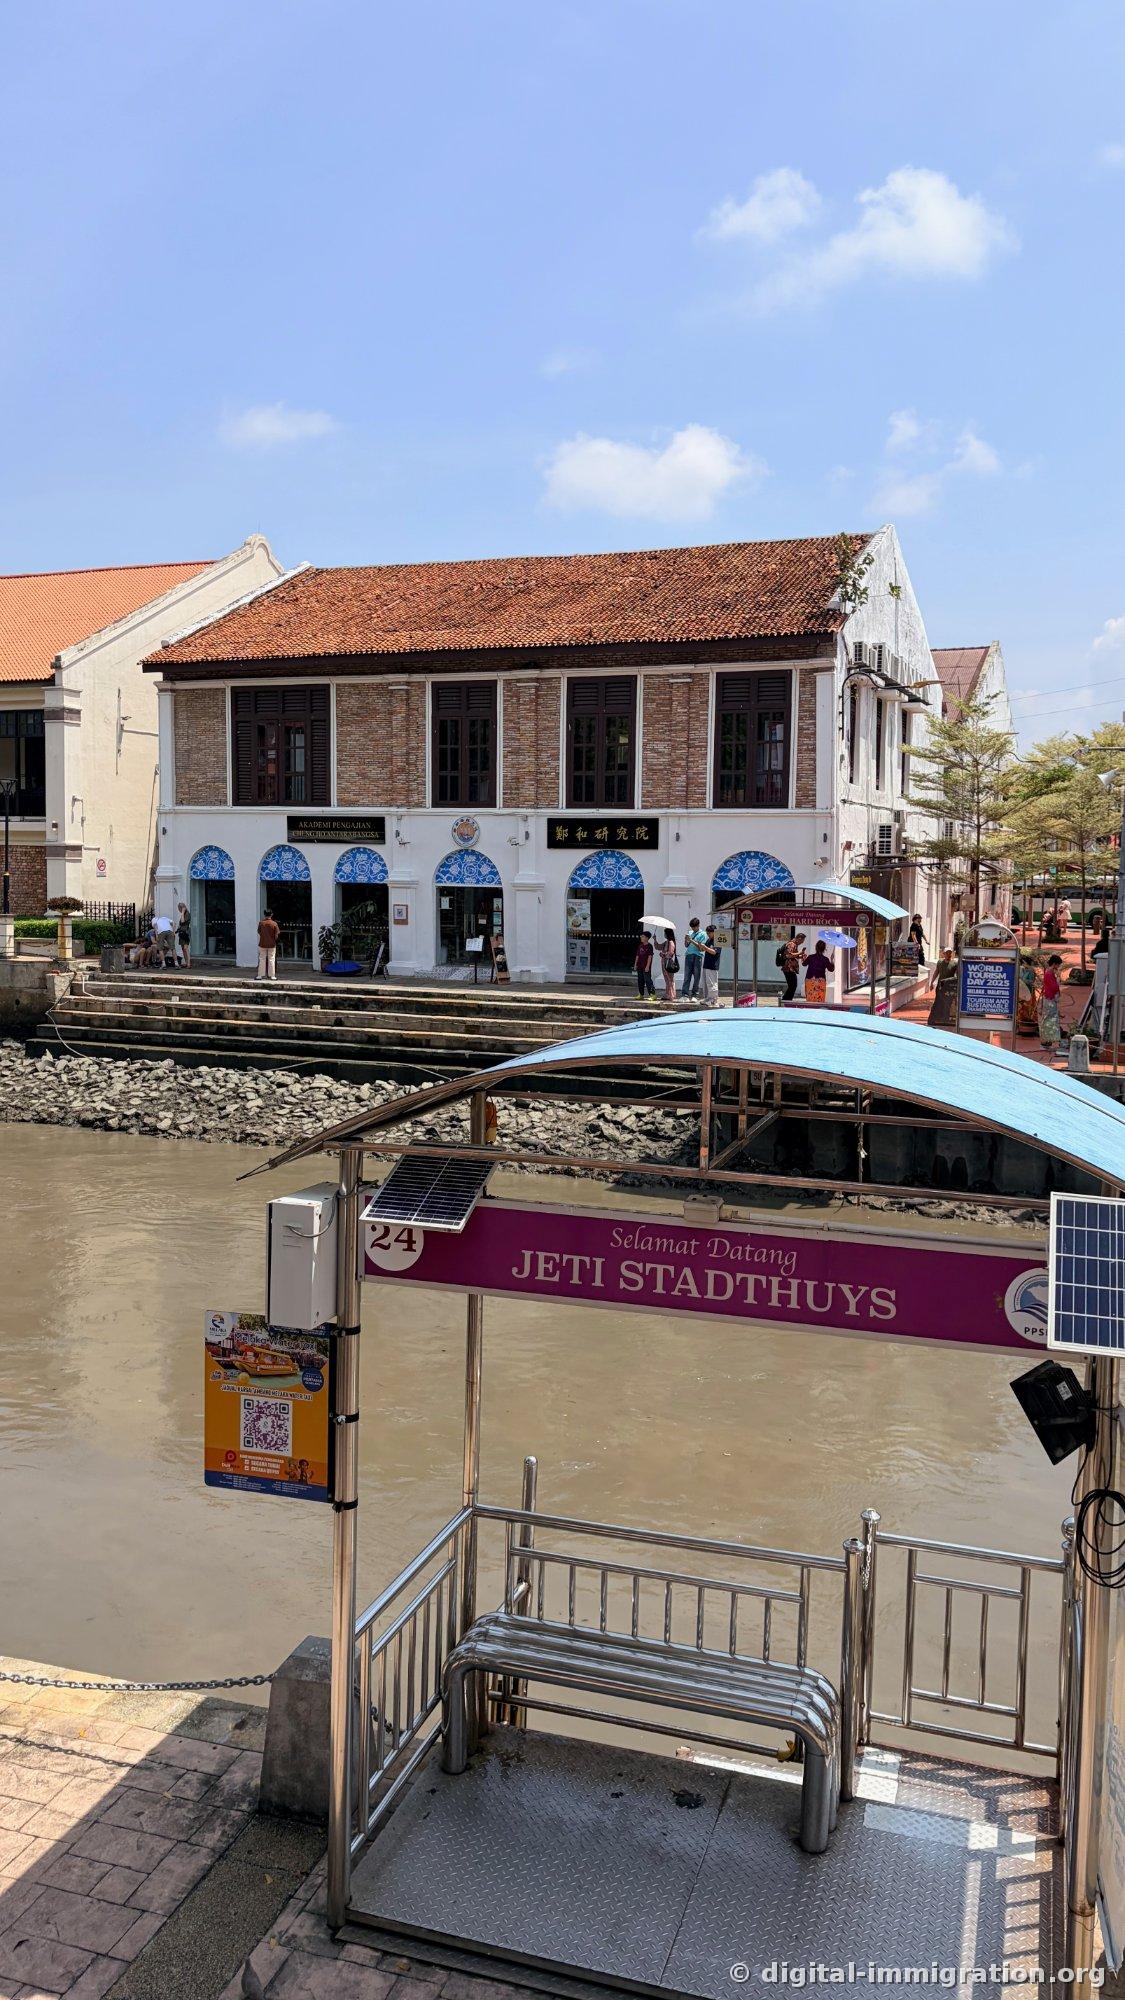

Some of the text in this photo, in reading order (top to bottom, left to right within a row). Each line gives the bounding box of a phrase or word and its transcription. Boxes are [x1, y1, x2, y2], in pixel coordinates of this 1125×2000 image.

[298, 821, 371, 829] AKADEMI PENGAJIAN
[769, 917, 789, 925] JETI
[814, 918, 840, 926] ROCK
[967, 964, 1003, 972] WORLD
[967, 971, 1007, 980] TOURISM
[967, 978, 985, 986] DAY
[370, 1224, 417, 1253] 24
[609, 1225, 798, 1277] Selamat Datang
[511, 1250, 897, 1320] JETI STADTHUYS
[1024, 1326, 1048, 1336] PPS
